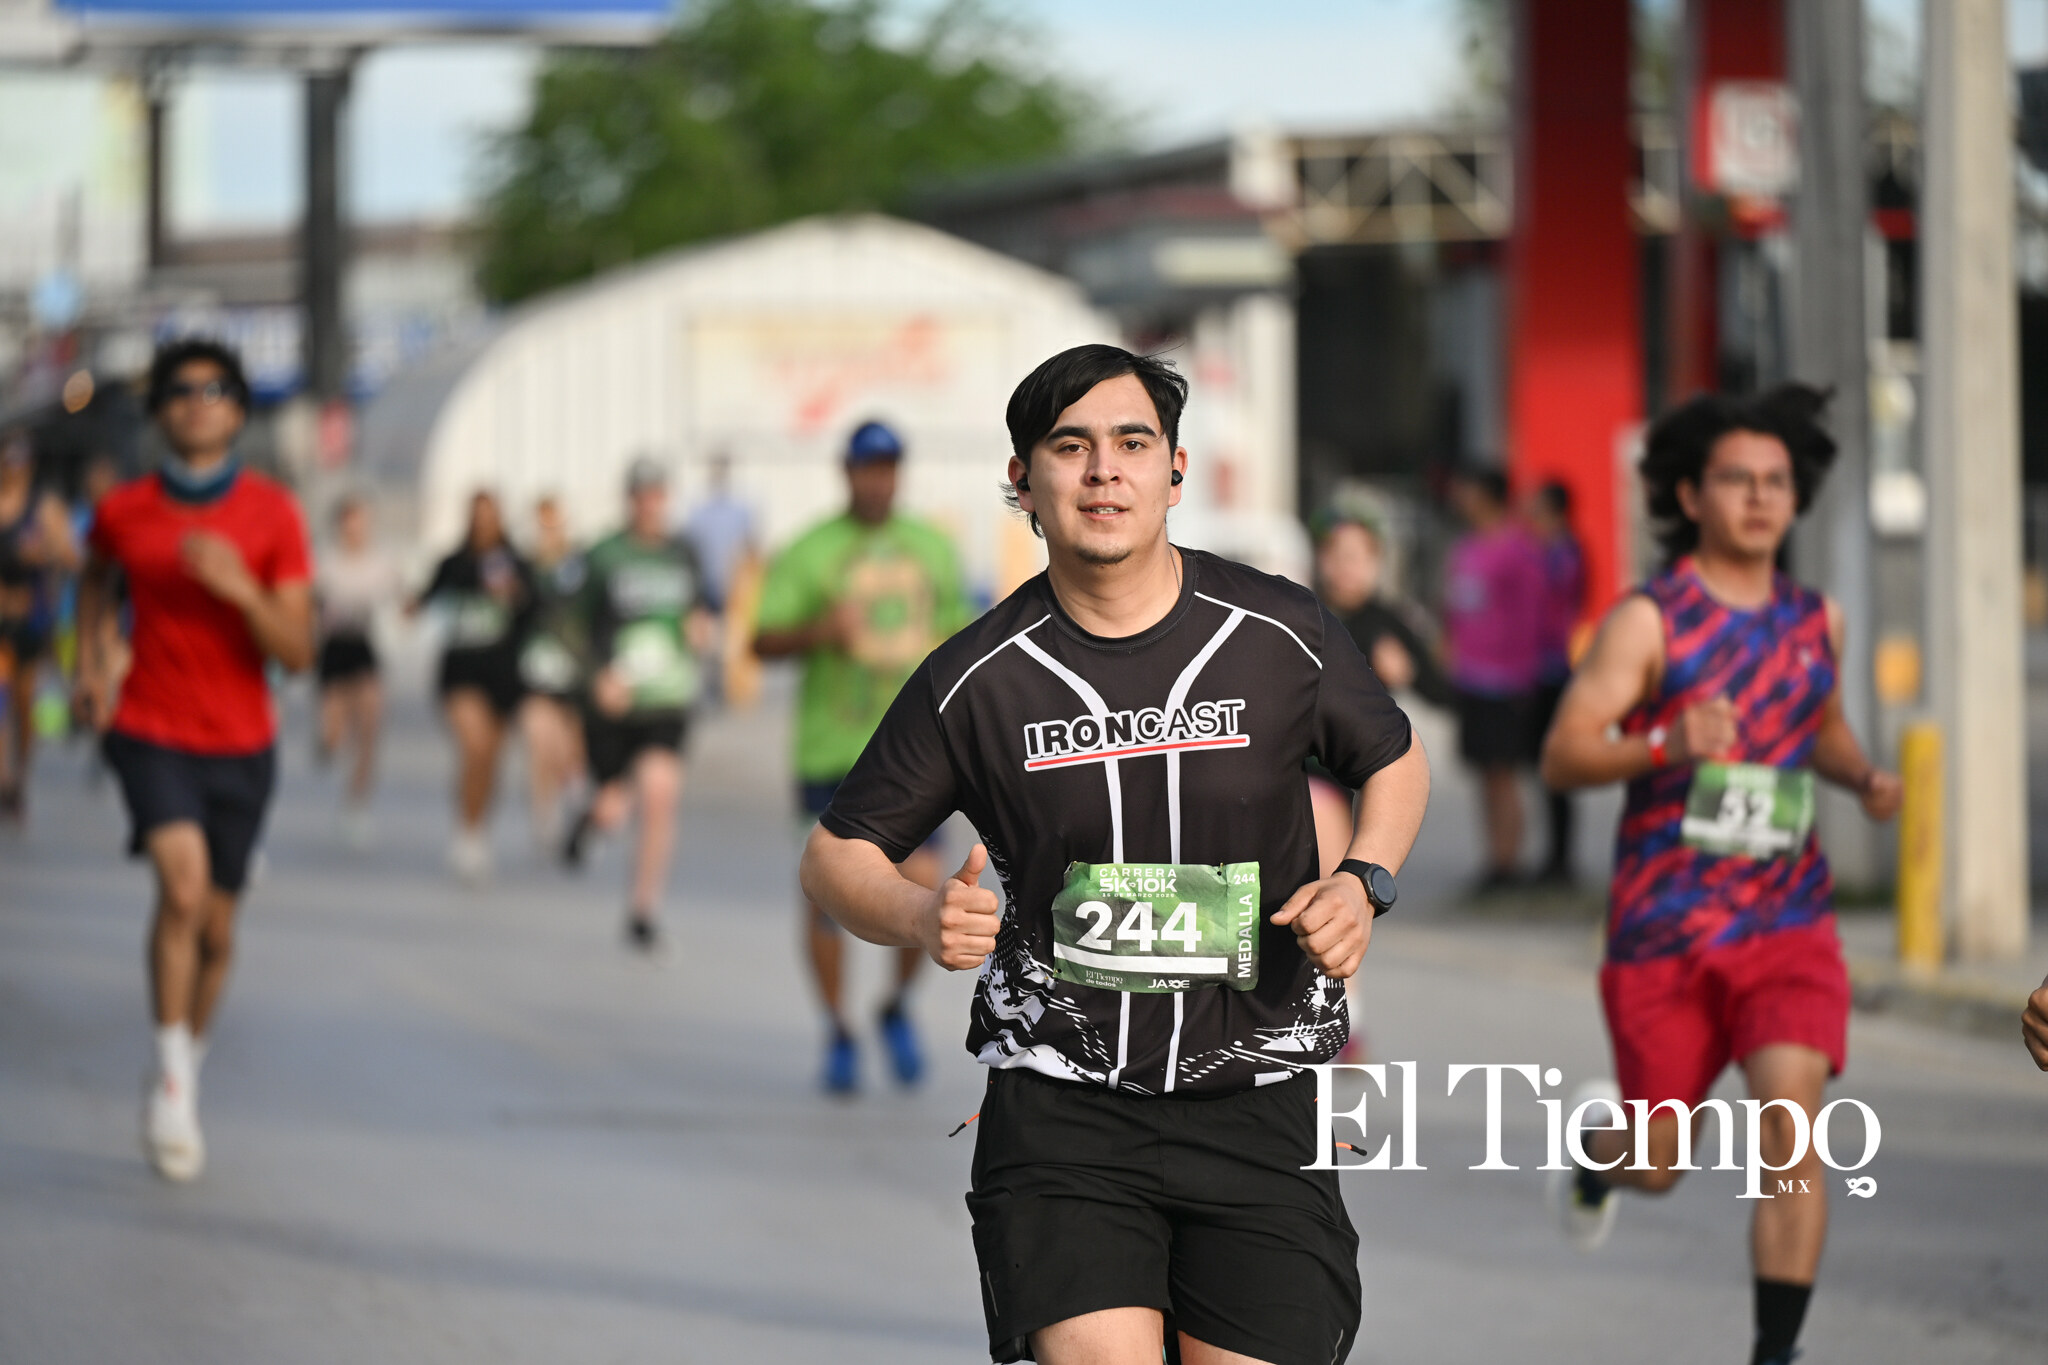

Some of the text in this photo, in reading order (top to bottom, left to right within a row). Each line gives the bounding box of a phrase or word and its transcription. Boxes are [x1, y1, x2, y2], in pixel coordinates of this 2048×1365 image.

[1025, 699, 1246, 759] IRONCAST
[1099, 868, 1177, 878] CARRERA
[1234, 873, 1256, 885] 244
[1075, 900, 1202, 952] 244
[1237, 894, 1253, 978] MEDALLA
[1085, 970, 1123, 984] El Tiempo
[1095, 980, 1116, 988] todos
